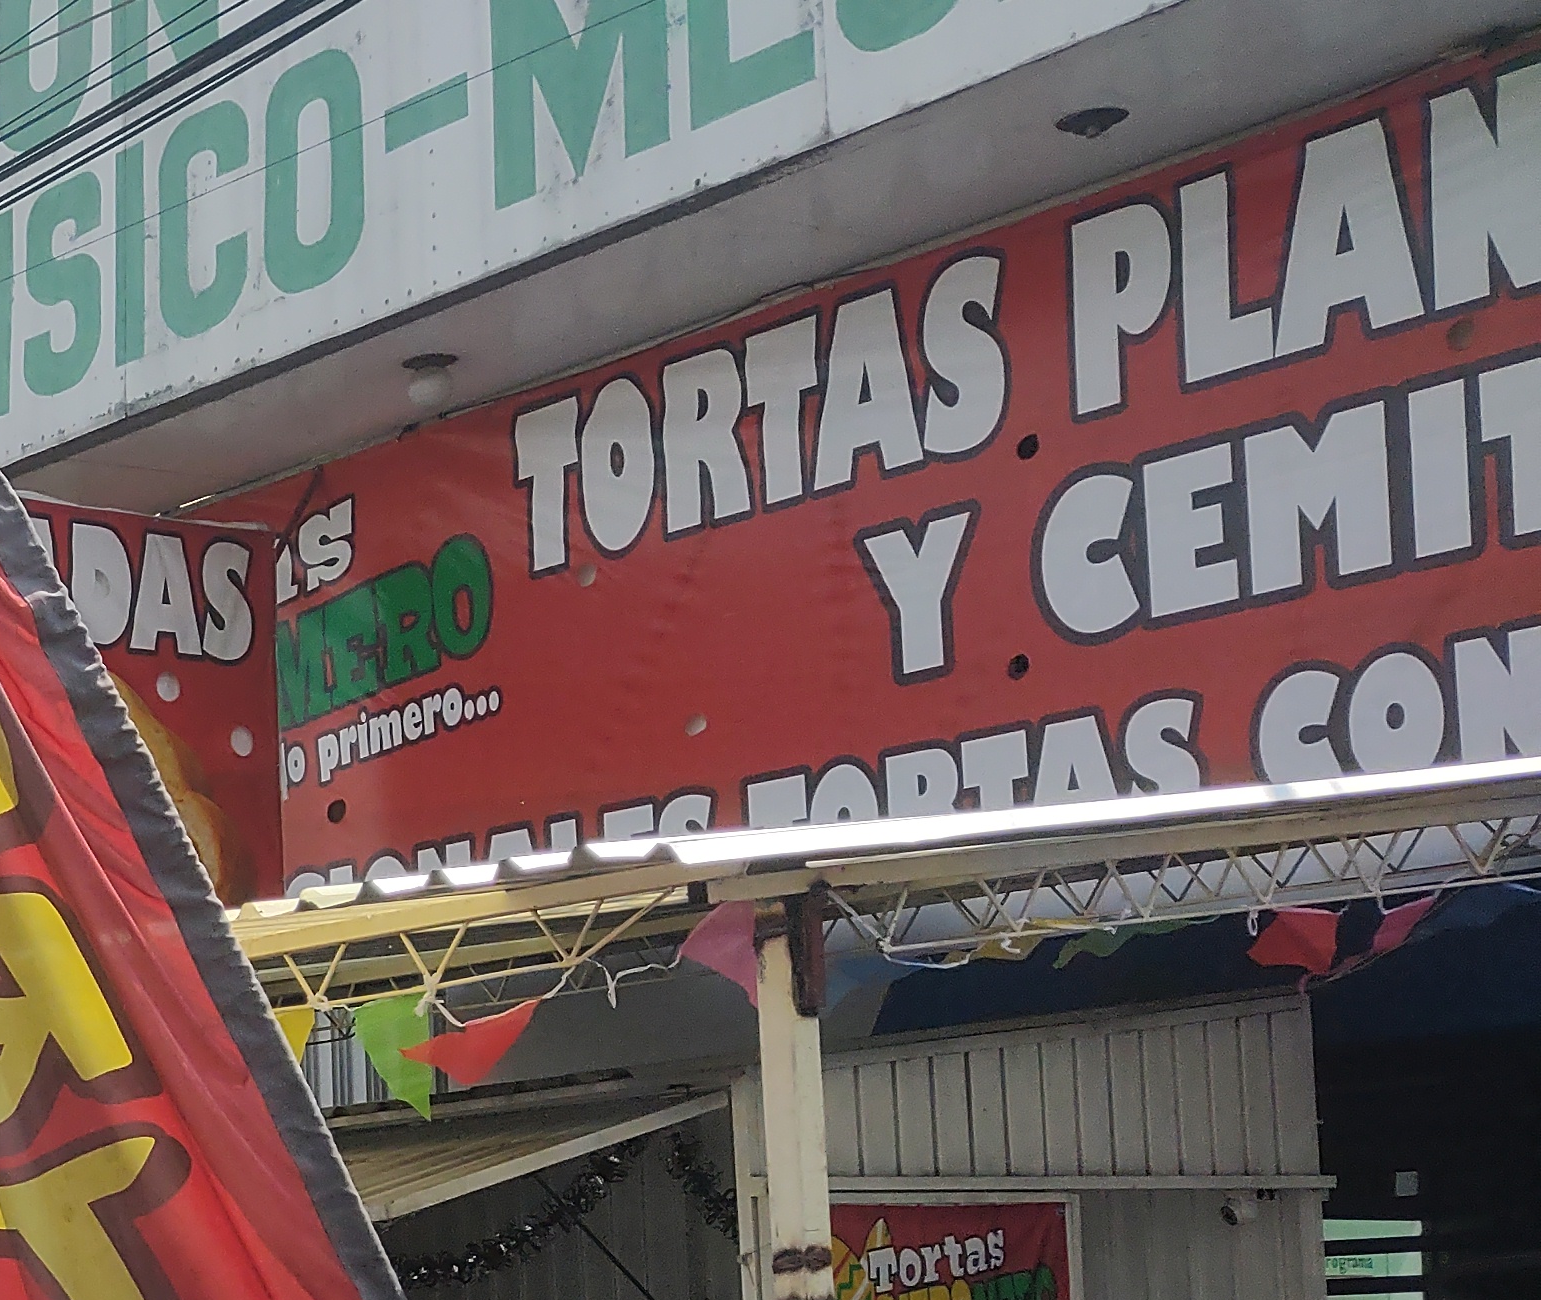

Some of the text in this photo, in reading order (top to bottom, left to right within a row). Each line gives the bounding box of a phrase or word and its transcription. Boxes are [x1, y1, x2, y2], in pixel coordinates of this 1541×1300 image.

[518, 62, 1541, 572] TORTAS PLAN
[276, 536, 491, 730] MERO
[864, 513, 970, 675] Y
[317, 687, 500, 782] primero...
[869, 1230, 1004, 1293] Tortas
